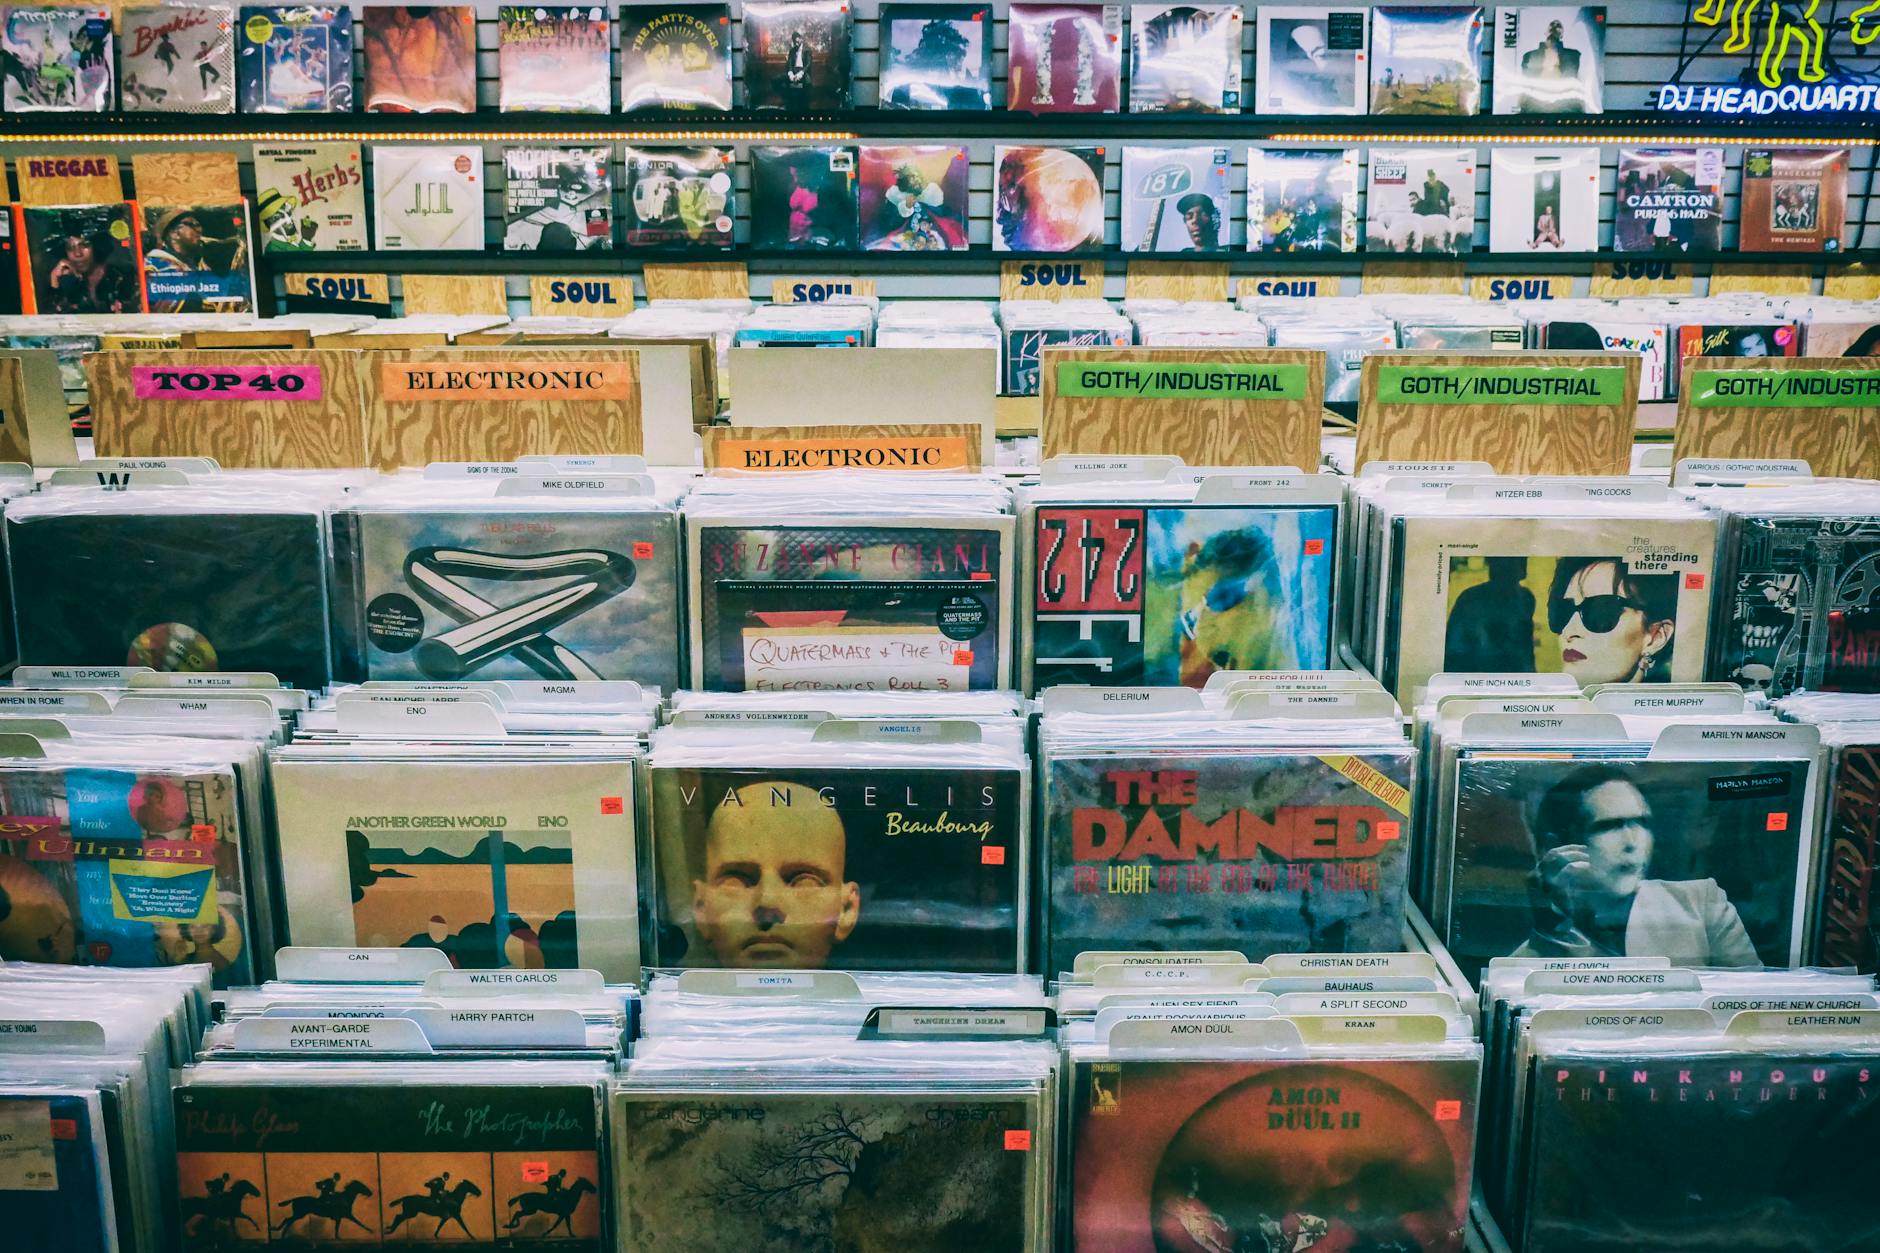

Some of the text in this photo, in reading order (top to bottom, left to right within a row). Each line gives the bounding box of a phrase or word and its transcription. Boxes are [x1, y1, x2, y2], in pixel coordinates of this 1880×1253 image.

[632, 13, 720, 53] THE PARTY'S OVER
[1504, 12, 1517, 48] NELLY
[1658, 84, 1694, 111] DJ
[29, 159, 109, 178] REGGAE
[1375, 166, 1405, 180] SHEEP
[292, 163, 361, 207] Herbs
[1143, 170, 1185, 194] 187
[1627, 194, 1714, 207] CAM'RON
[1019, 264, 1087, 286] SOUL
[1612, 262, 1676, 280] SOUL
[150, 282, 220, 295] Ethiopian Jazz
[306, 277, 372, 299] SOUL
[551, 281, 617, 304] SOUL
[1490, 279, 1554, 301] SOUL
[152, 373, 305, 392] TOP 40
[405, 370, 604, 390] ELECTRONIC
[1081, 370, 1284, 393] GOTH/INDUSTRIAL
[1401, 376, 1601, 399] GOTH/INDUSTRIAL
[1715, 378, 1880, 399] GOTH/INDUSTR
[119, 461, 166, 469] PAUL YOUNG
[744, 448, 941, 469] ELECTRONIC
[467, 466, 481, 474] SIGNS
[500, 466, 518, 474] ZODIAC
[98, 472, 130, 491] W
[543, 481, 604, 489] MIKE OLDFIELD
[1495, 490, 1524, 498] NITZER
[1633, 535, 1650, 546] the
[1626, 543, 1676, 553] creatures
[713, 543, 988, 573] SUZANNE CIANI
[1643, 552, 1698, 564] standing
[1634, 560, 1668, 571] there
[51, 670, 120, 679] WILL TO POWER
[543, 685, 576, 694] MAGMA
[888, 677, 930, 690] ROLL
[937, 678, 949, 690] 3
[1465, 679, 1531, 687] NINE INCH NAILS
[28, 697, 36, 705] IN
[38, 697, 65, 705] ROME
[1103, 692, 1150, 701] DELERIUM
[1634, 698, 1704, 708] PETER MURPHY
[180, 702, 207, 710] WHAM
[406, 706, 427, 715] ENO
[1503, 704, 1555, 713] MISSION UK
[879, 725, 921, 733] VANGELIS
[1521, 719, 1563, 728] MINISTRY
[1701, 730, 1786, 740] MARILYN MANSON
[1342, 756, 1406, 806] DOUBLE ALBUM
[1106, 770, 1200, 806] THE
[76, 790, 98, 803] You
[680, 786, 994, 807] VANGELIS
[346, 815, 568, 829] ANOTHER GREEN WORLD ENO
[885, 811, 994, 841] Beaubourg
[1072, 804, 1393, 862] DAMNED
[38, 840, 204, 859] Ullman
[1107, 864, 1152, 894] LIGHT
[1186, 864, 1213, 893] THE
[1259, 864, 1277, 891] OF
[1287, 863, 1315, 893] THE
[348, 953, 369, 961] CAN
[1299, 957, 1389, 967] CHRISTIAN DEATH
[470, 973, 557, 983] WALTER CARLOS
[1145, 970, 1191, 978] C.C.C.P.
[1563, 974, 1665, 984] LOVE AND ROCKETS
[1324, 981, 1374, 991] BAUHAUS
[1320, 999, 1408, 1009] A SPLIT SECOND
[1711, 1000, 1861, 1011] LORDS OF THE NEW CHURCH
[451, 1012, 535, 1022] HARRY PARTCH
[913, 1017, 1006, 1025] TANGERINE DREAM
[1585, 1015, 1663, 1026] LORDS OF ACID
[1788, 1016, 1861, 1025] LEATHER NUN
[291, 1024, 370, 1034] AVANT-GARDE
[1171, 1025, 1202, 1034] AMON
[290, 1038, 373, 1048] EXPERIMENTAL
[1556, 1070, 1692, 1084] PINK
[1267, 1087, 1343, 1105] AMON
[418, 1100, 583, 1144] The Photographer
[1341, 1110, 1361, 1130] II
